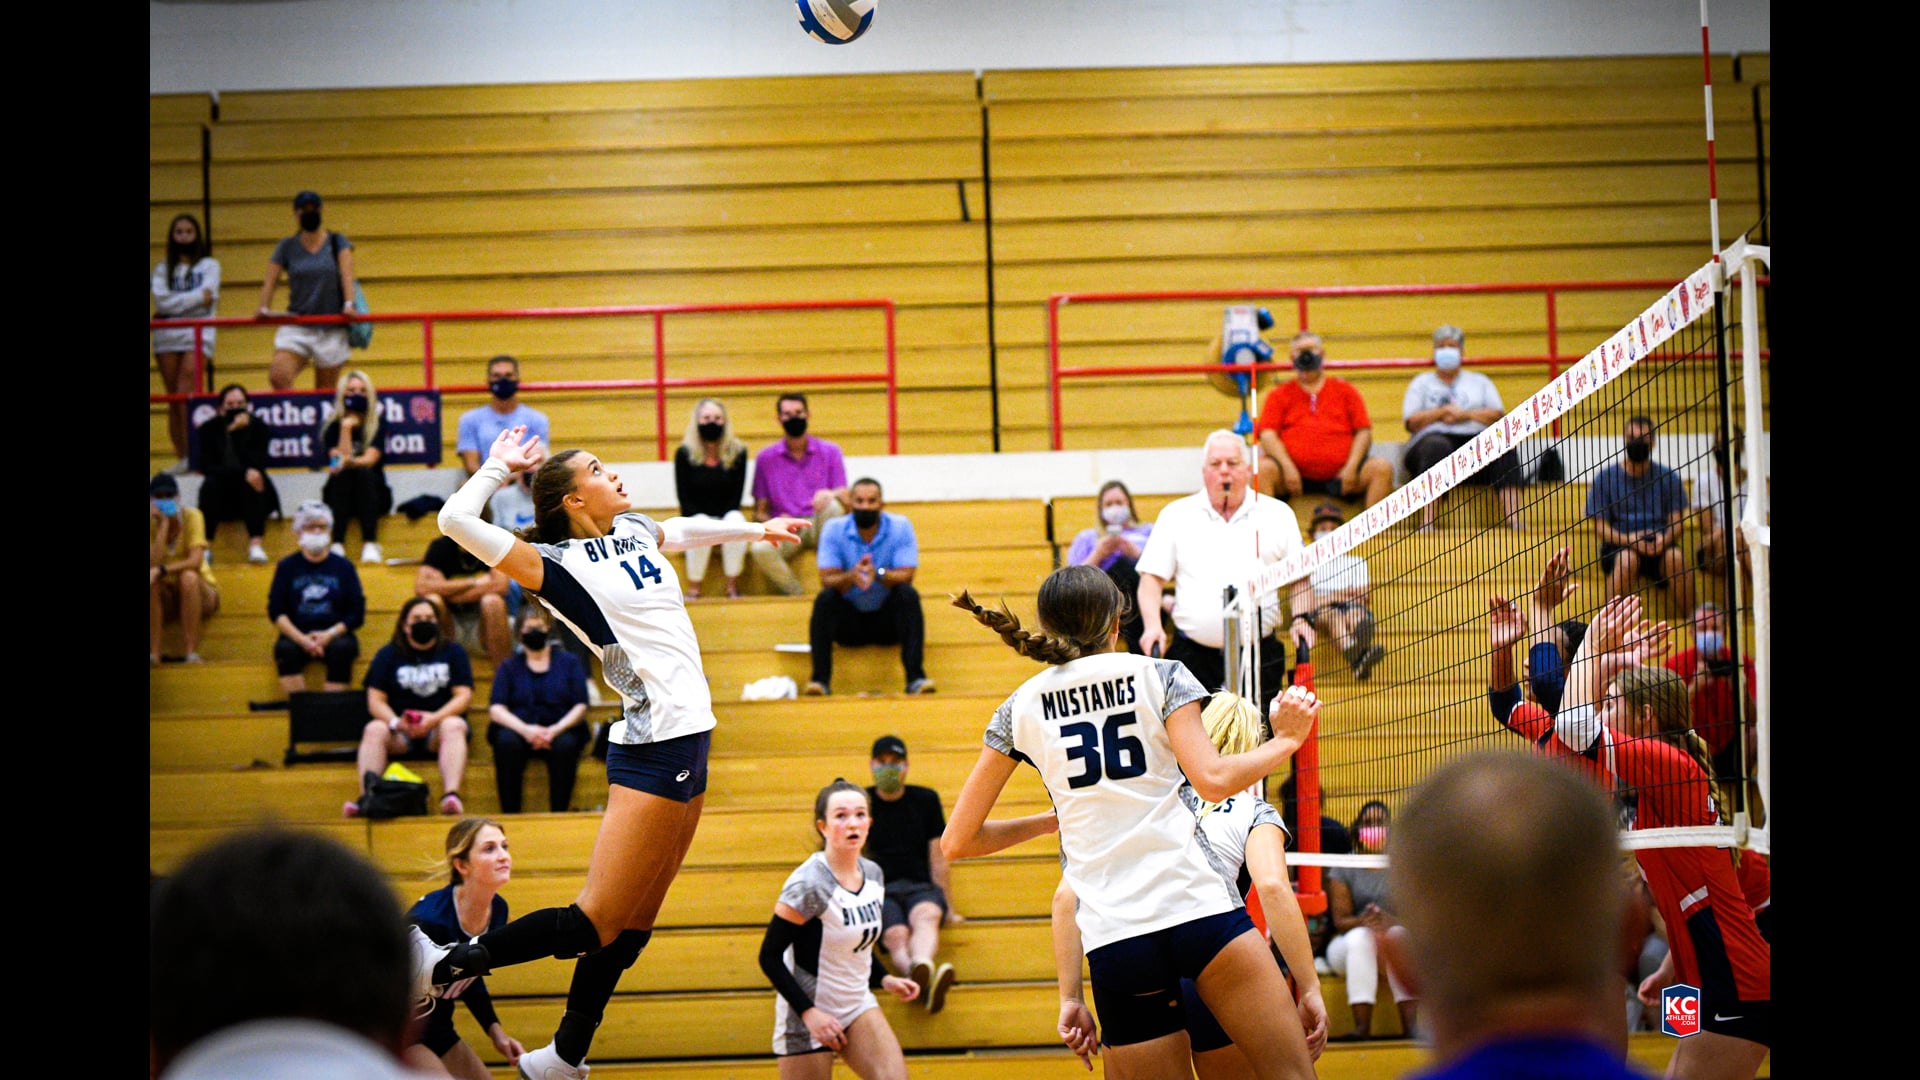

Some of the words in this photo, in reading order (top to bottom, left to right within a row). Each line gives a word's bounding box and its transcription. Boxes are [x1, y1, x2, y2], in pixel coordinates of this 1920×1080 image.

[583, 537, 609, 563] BV
[619, 554, 662, 590] 14
[1041, 675, 1136, 721] MUSTANGS
[1059, 711, 1147, 790] 36
